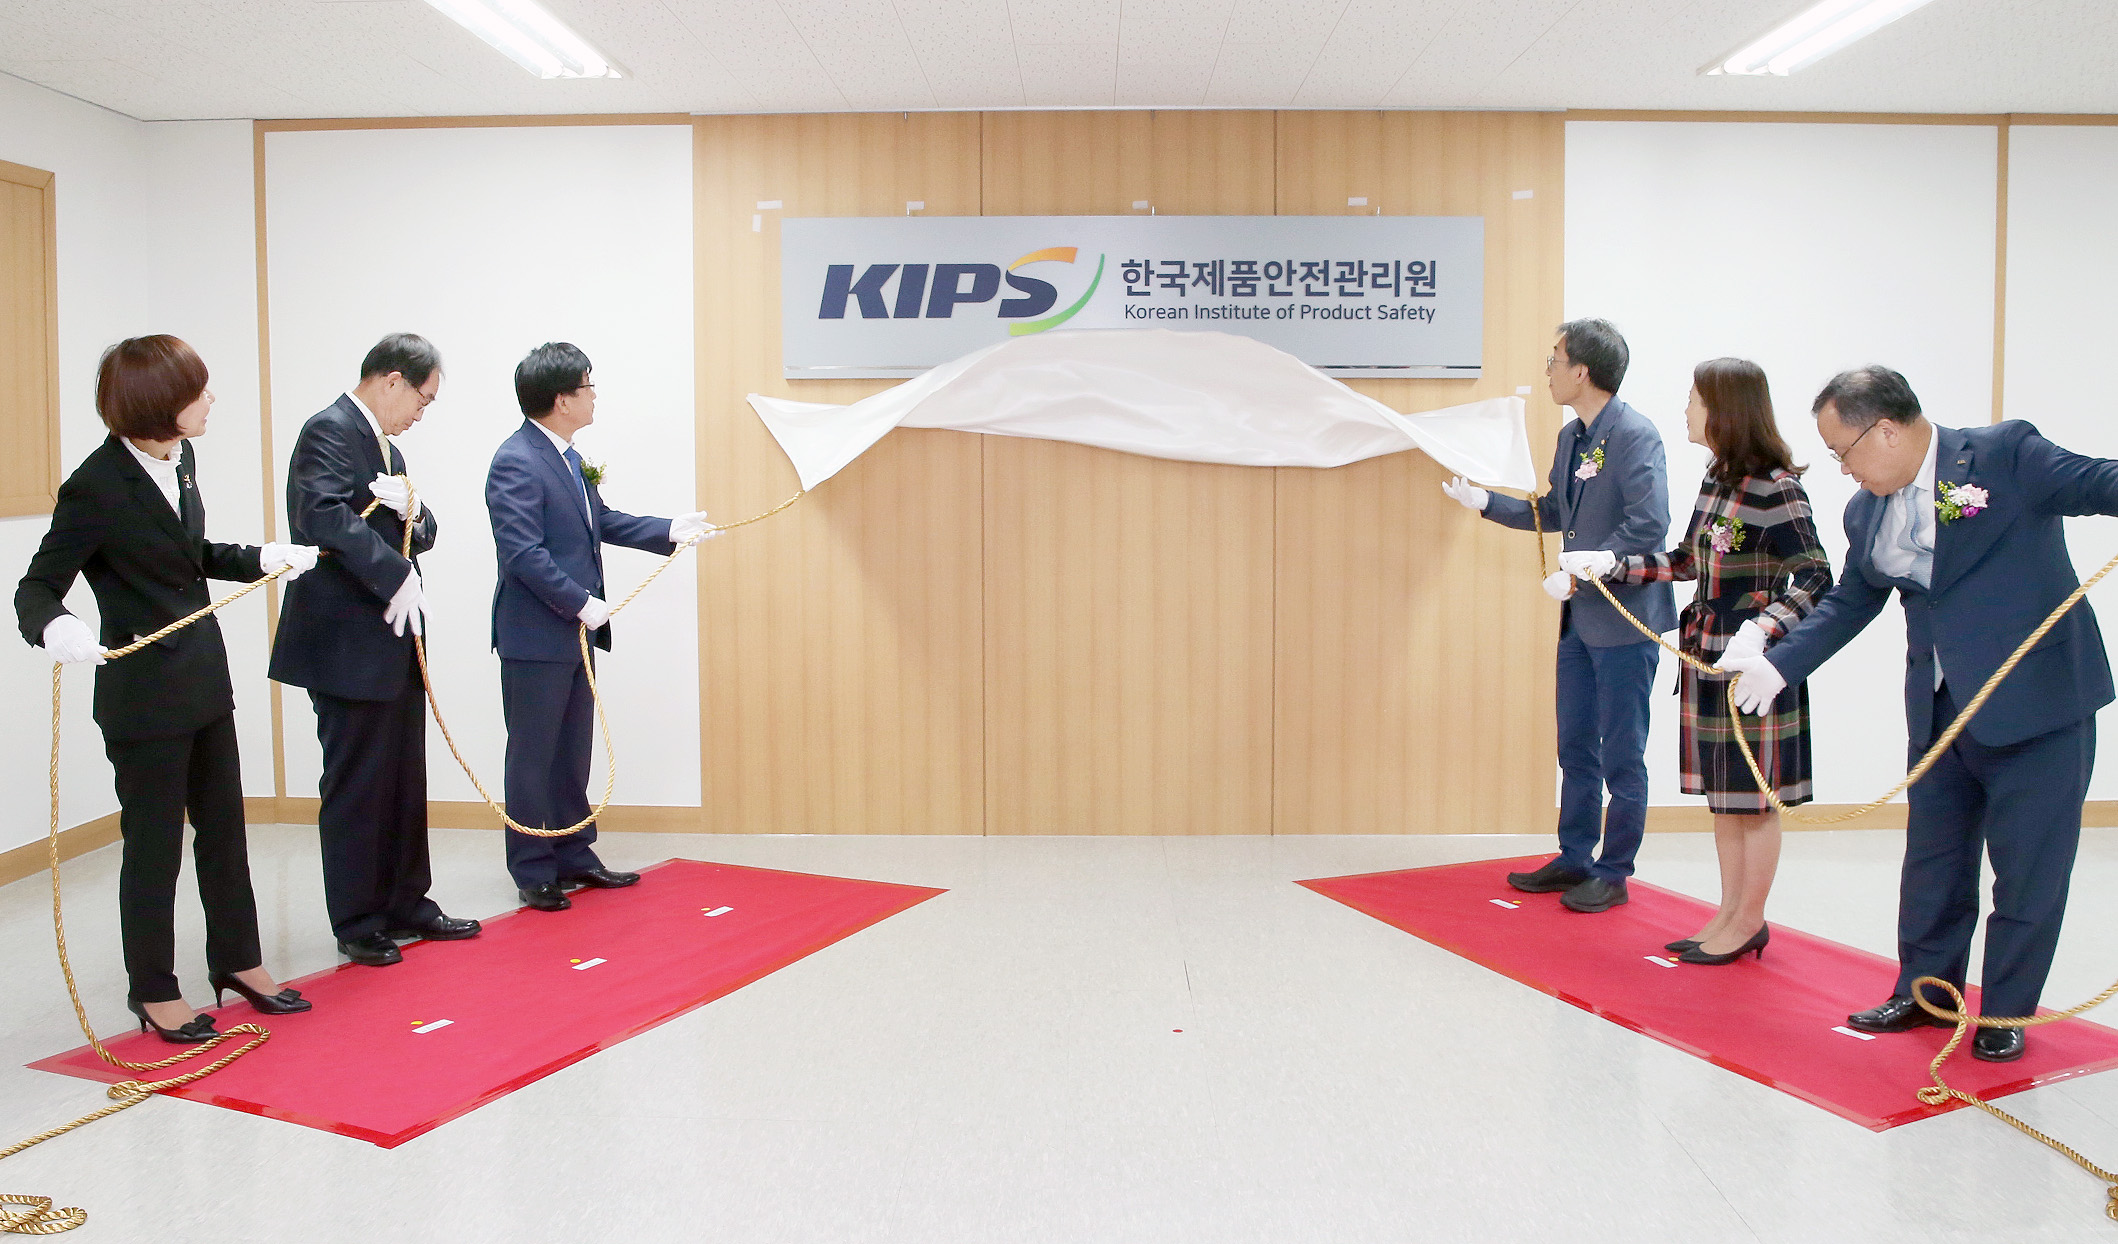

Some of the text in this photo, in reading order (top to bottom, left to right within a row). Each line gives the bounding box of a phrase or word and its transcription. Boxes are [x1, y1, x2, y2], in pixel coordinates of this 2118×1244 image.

[819, 247, 1078, 320] KIPS
[1120, 258, 1437, 298] 한국제품안전관리원
[1124, 303, 1436, 324] Korean Institute of Product Safety
